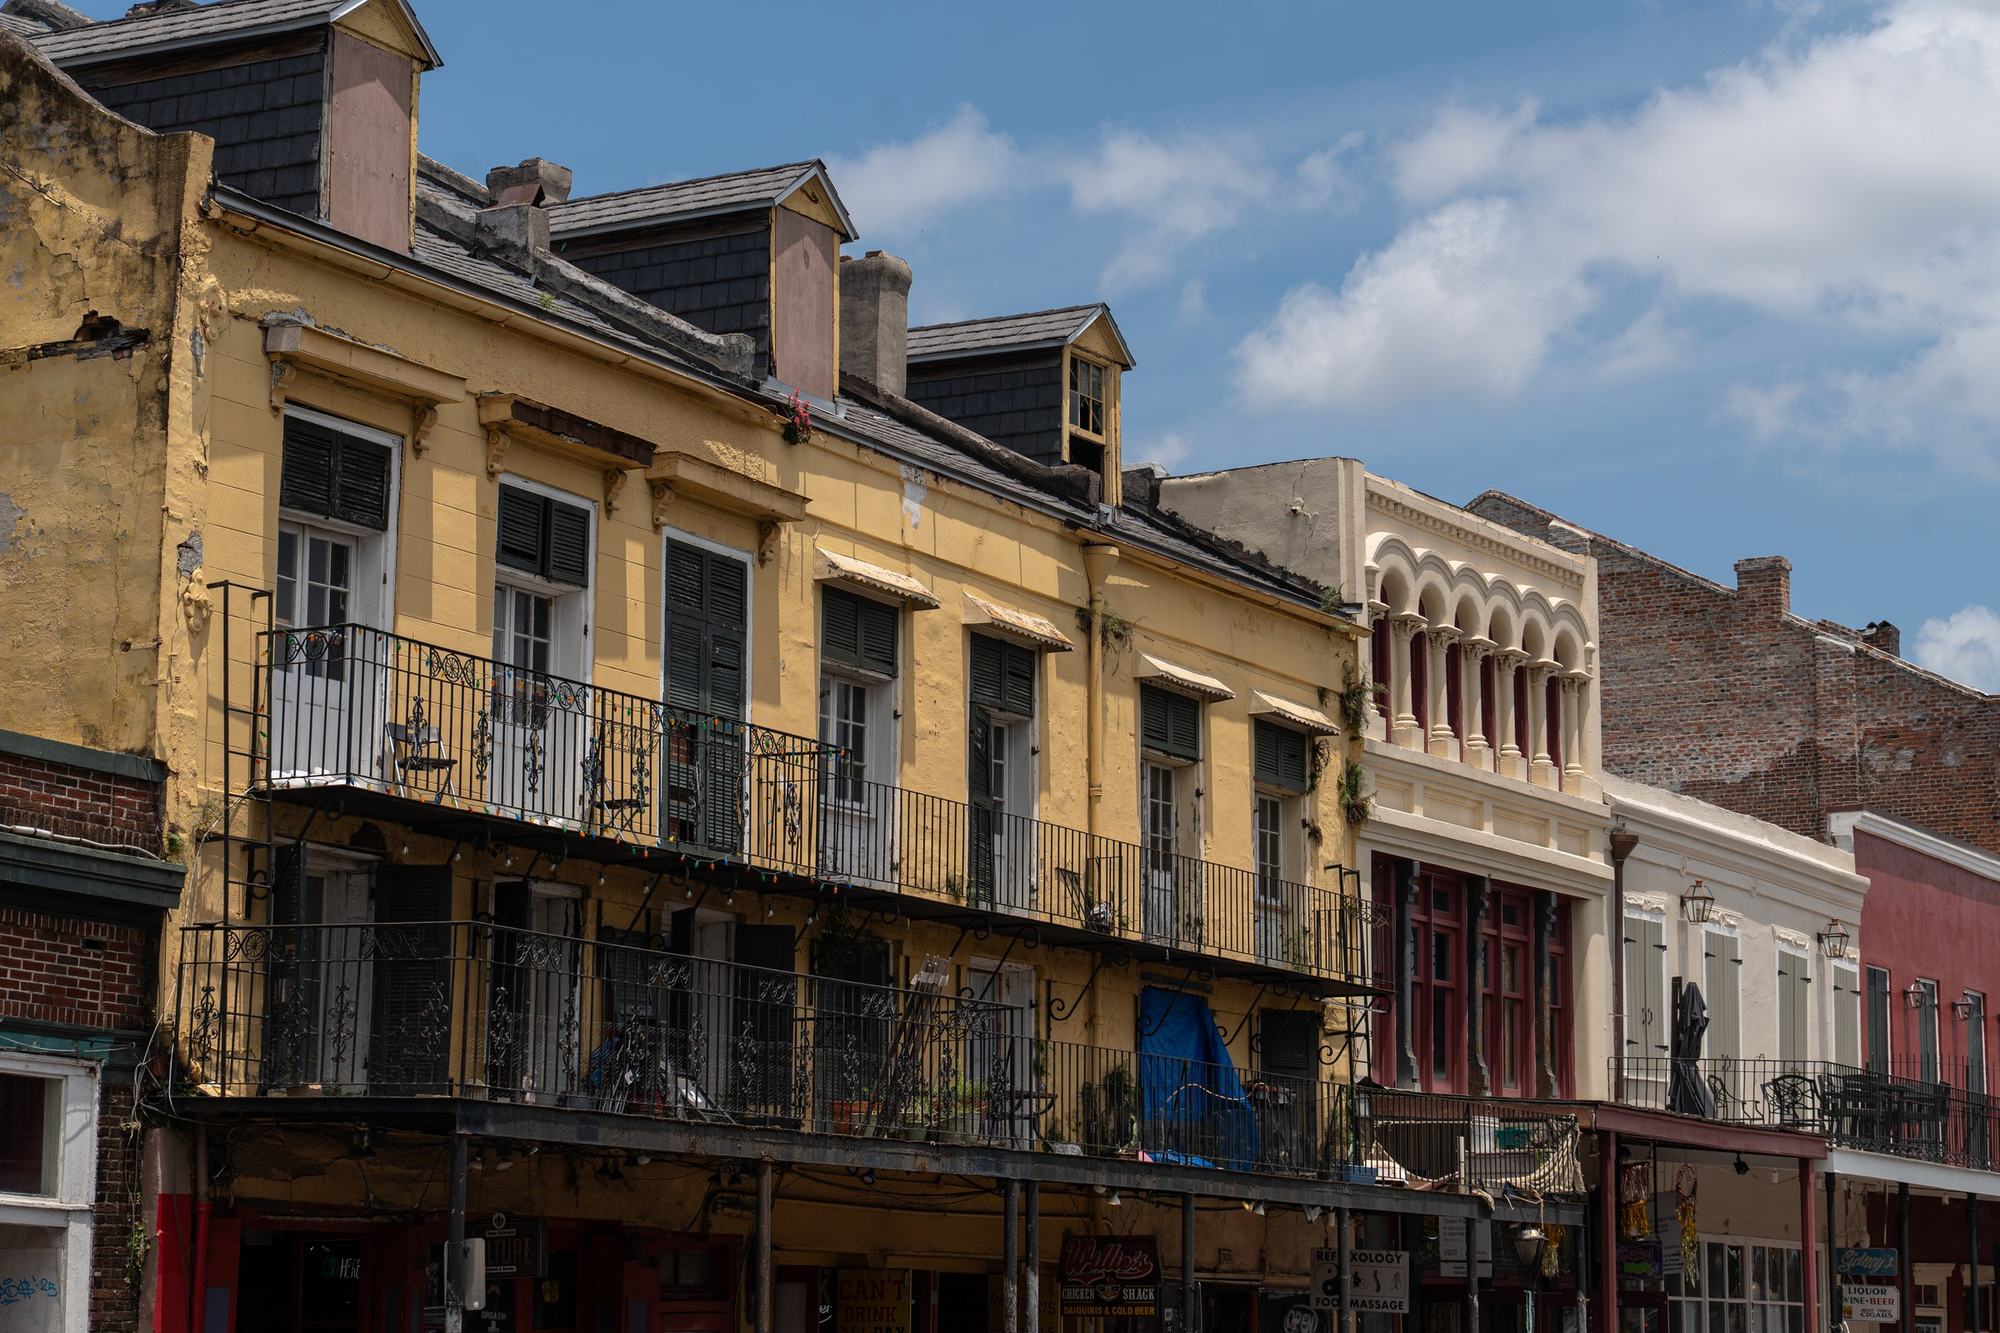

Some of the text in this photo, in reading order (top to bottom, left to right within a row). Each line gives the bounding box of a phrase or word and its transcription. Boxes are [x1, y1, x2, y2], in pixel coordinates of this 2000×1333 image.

[487, 1237, 532, 1265] LTURE
[1065, 1238, 1153, 1275] Willie's
[1316, 1251, 1403, 1264] REFXOLOGY
[1838, 1249, 1894, 1274] Sidney's
[839, 1277, 906, 1301] CAN'T
[1062, 1288, 1155, 1300] CHICKEN SHACK
[1848, 1286, 1887, 1296] LIQUOR
[1315, 1297, 1404, 1311] FOO MASSAGE
[1869, 1297, 1894, 1306] BEER
[846, 1306, 896, 1322] DRINK
[1063, 1306, 1103, 1315] DAIQUIRIS
[1112, 1306, 1133, 1315] COLD
[1134, 1306, 1156, 1316] BEER
[1860, 1311, 1893, 1319] CIGARS
[1286, 1309, 1316, 1333] OPEN
